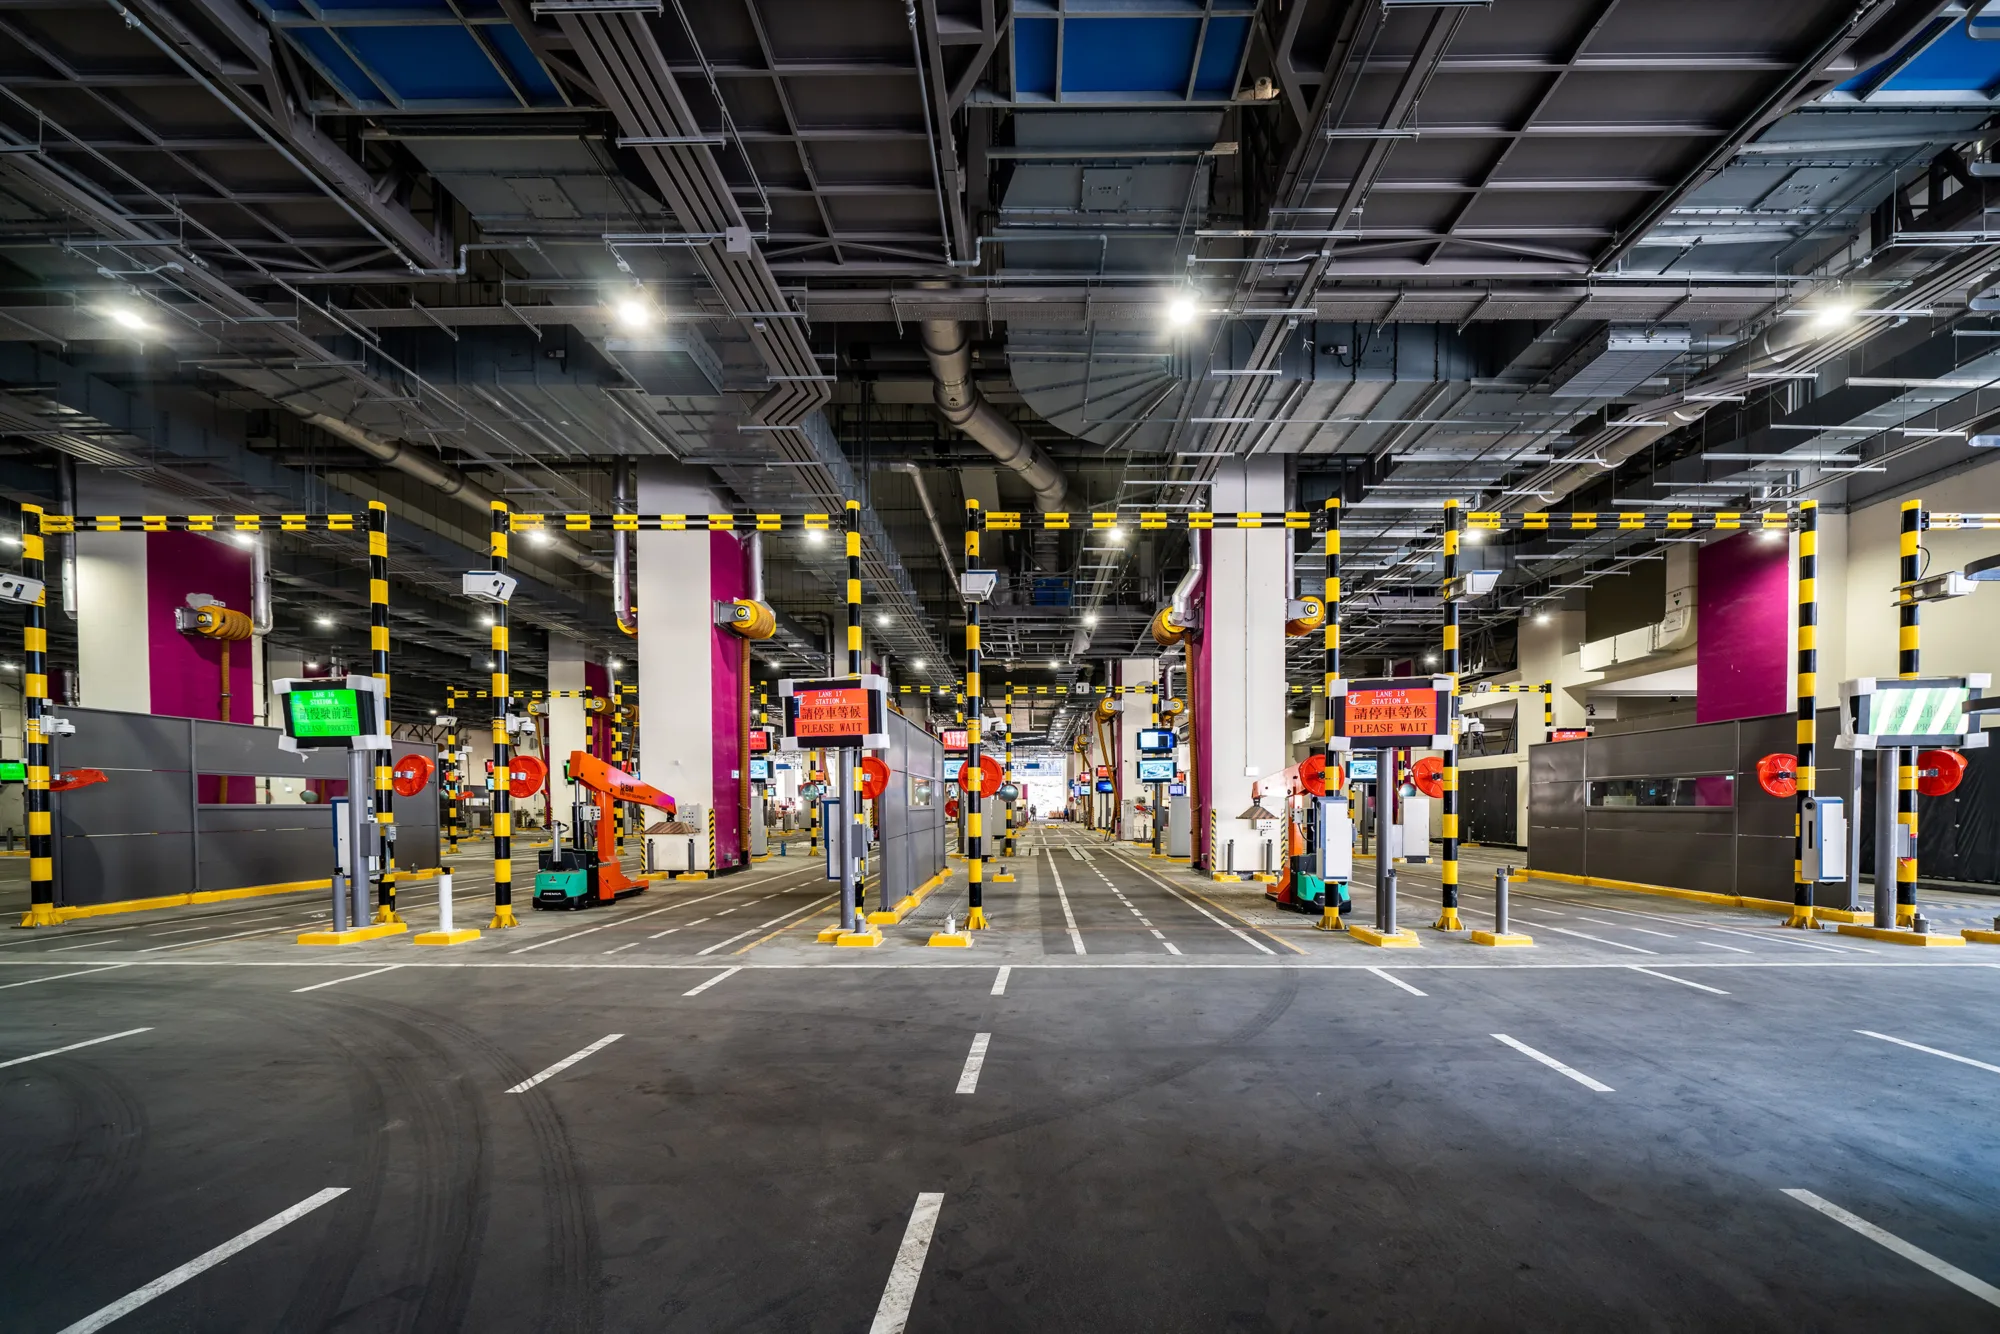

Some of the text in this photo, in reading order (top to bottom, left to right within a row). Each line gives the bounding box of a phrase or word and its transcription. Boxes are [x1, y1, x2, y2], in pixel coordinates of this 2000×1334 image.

[299, 706, 353, 720] 請慢駛前進
[802, 705, 860, 719] 請停車等候
[1354, 705, 1427, 719] 請停車等候
[299, 724, 356, 733] PLEASE PROCEED
[801, 722, 863, 734] PLEASE WAIT
[1353, 722, 1428, 734] PLEASE WAIT
